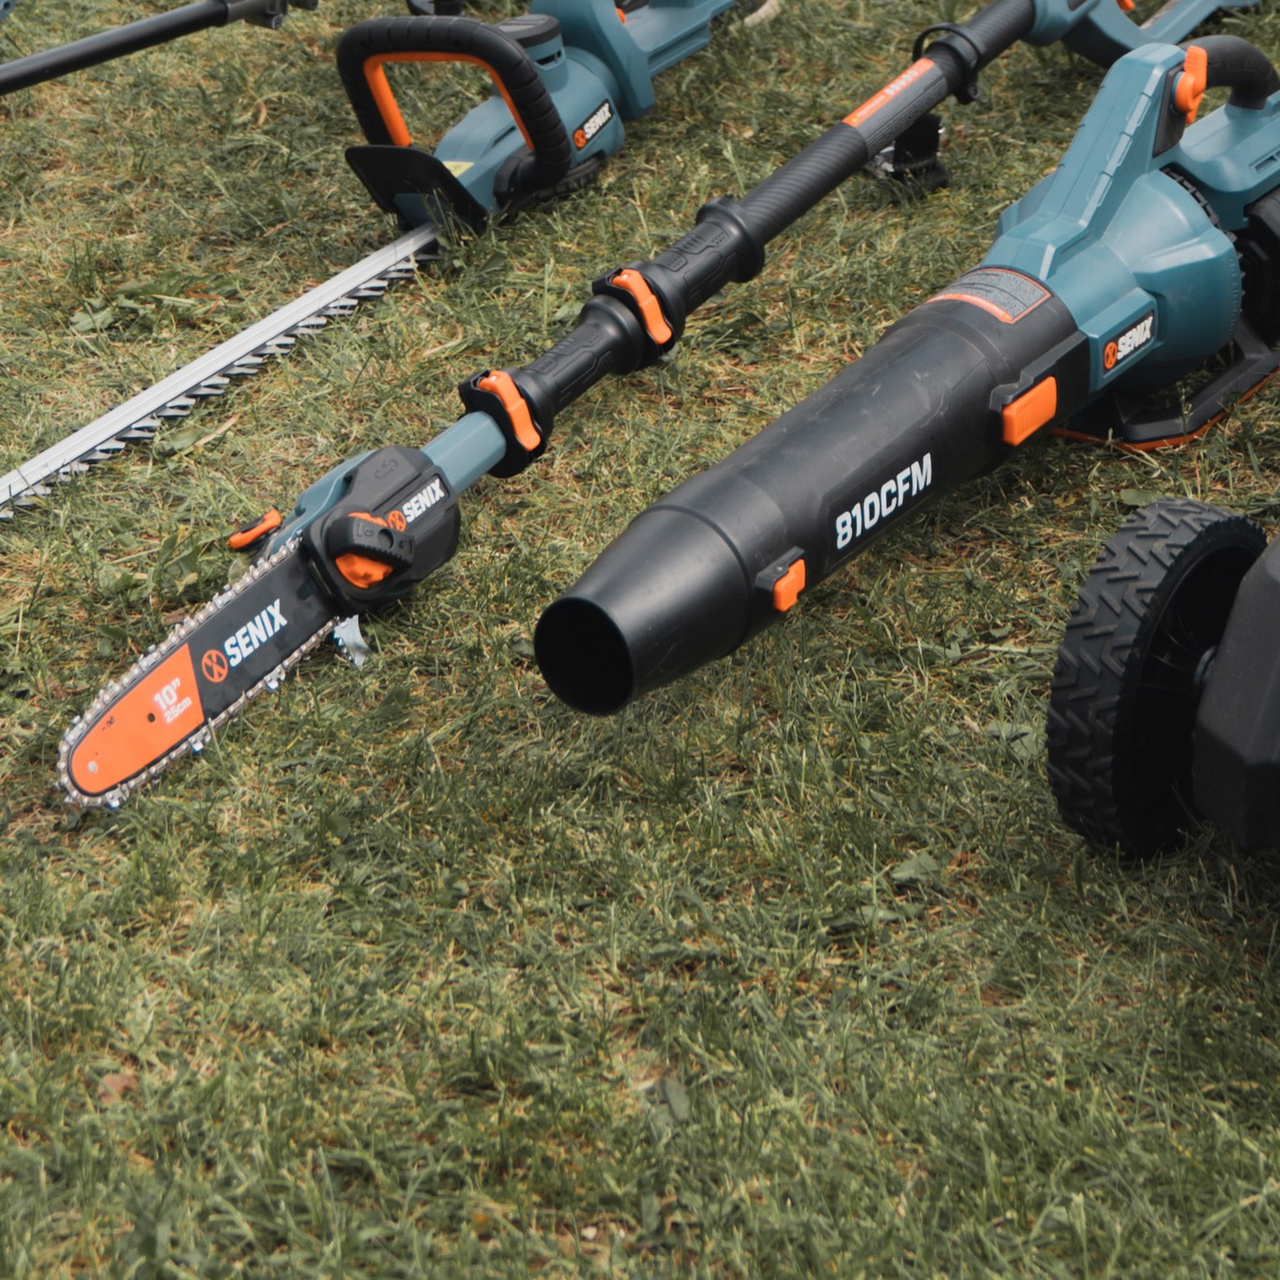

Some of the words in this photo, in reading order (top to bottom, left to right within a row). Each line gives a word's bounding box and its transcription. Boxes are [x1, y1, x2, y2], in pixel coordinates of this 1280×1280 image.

[583, 103, 611, 139] SENIX
[1117, 315, 1153, 360] SENIX
[402, 478, 445, 523] SENIX
[835, 452, 932, 549] 810CFM
[223, 598, 288, 668] SENIX
[163, 696, 193, 725] 25cm
